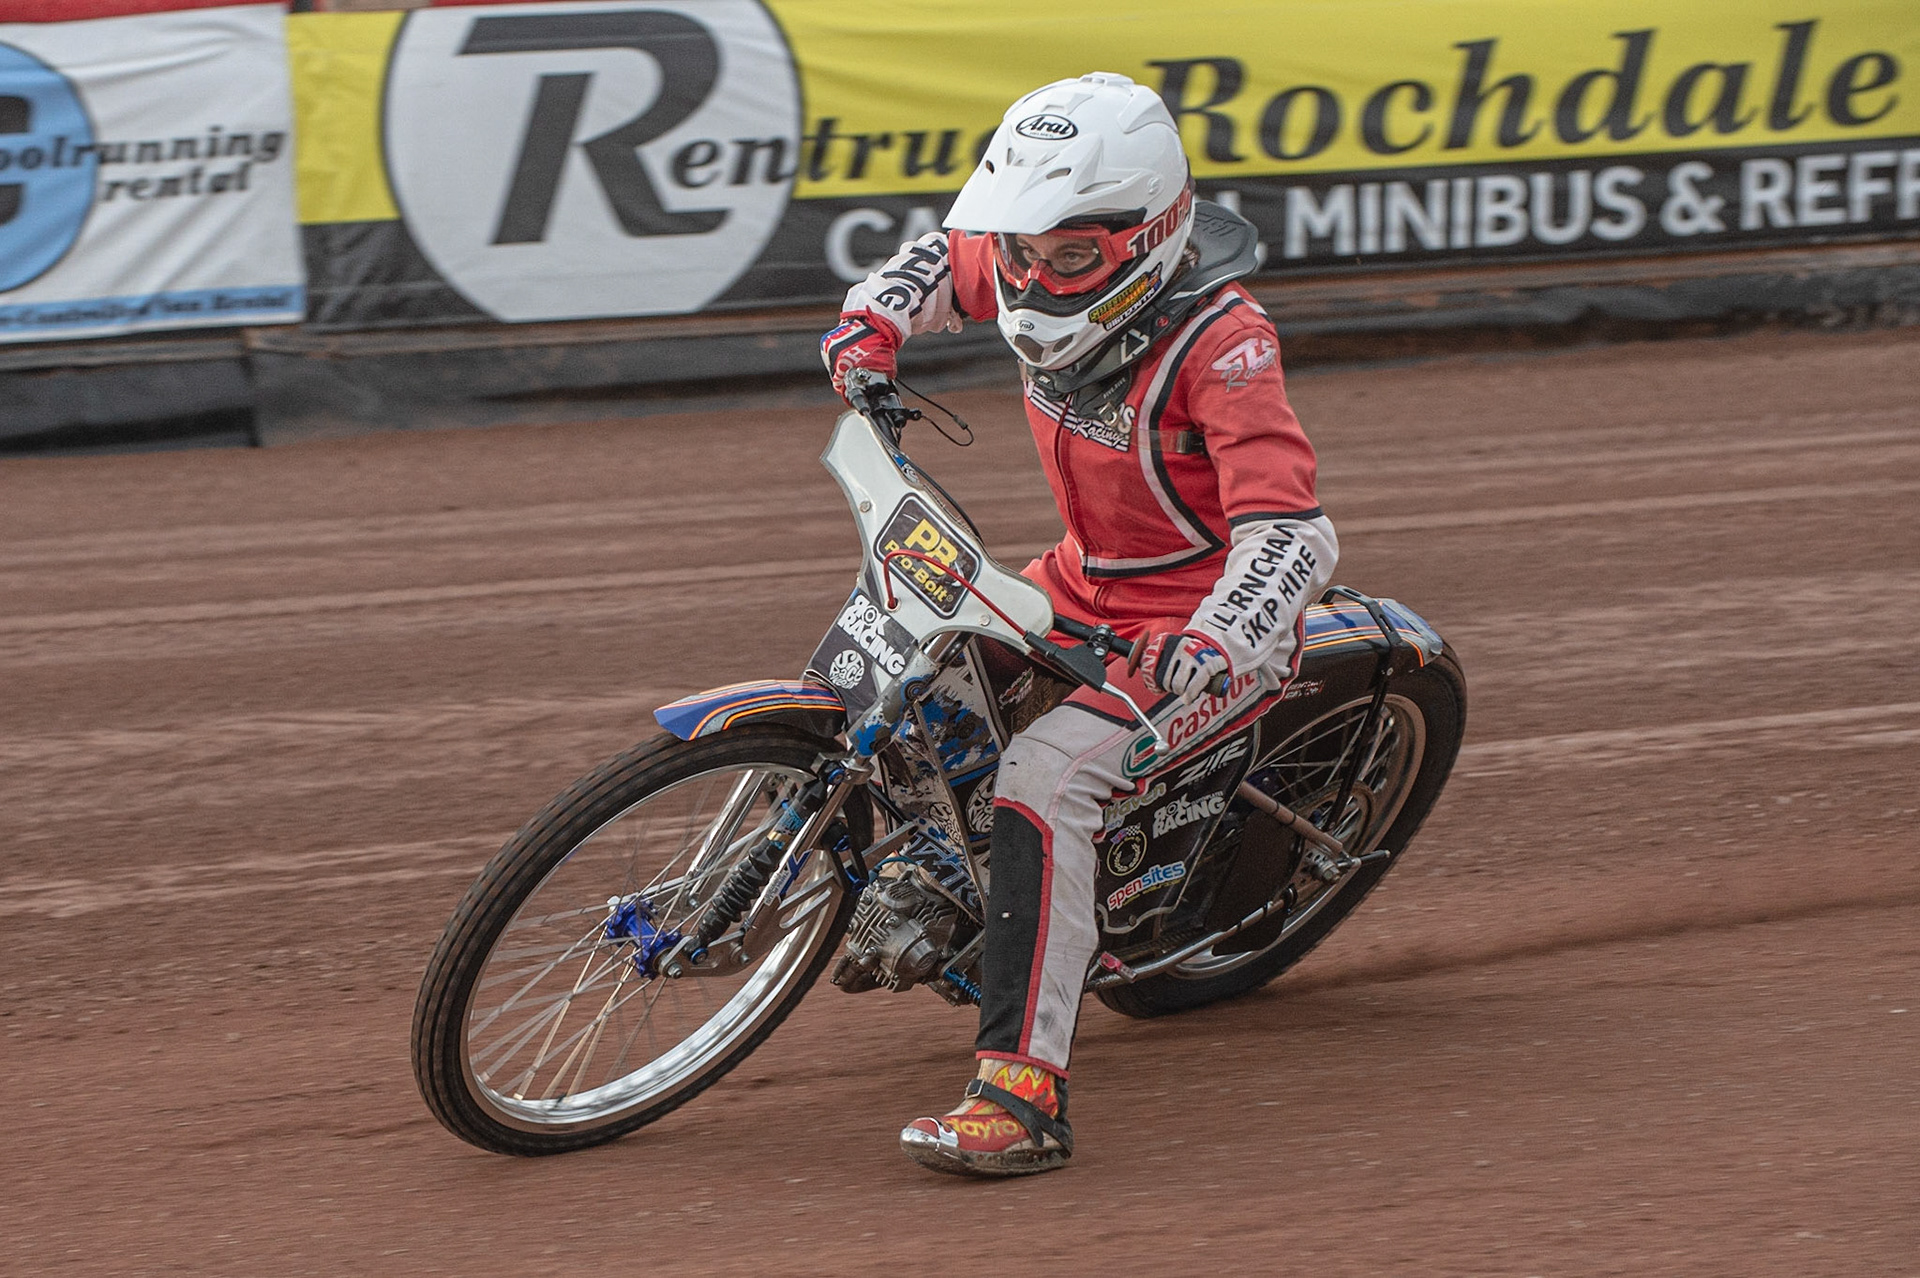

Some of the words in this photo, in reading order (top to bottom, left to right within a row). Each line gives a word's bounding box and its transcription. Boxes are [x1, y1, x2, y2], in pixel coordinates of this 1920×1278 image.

[1145, 18, 1902, 165] Rochdale
[456, 10, 1000, 246] Rentru
[1020, 116, 1071, 135] Arai
[104, 162, 251, 202] rental
[825, 207, 940, 283] CA
[1284, 168, 1646, 258] MINIBUS
[1659, 161, 1727, 237] &
[884, 539, 949, 603] Po-Bolt
[903, 518, 958, 576] PB
[1278, 545, 1317, 605] HIRE
[837, 604, 906, 675] RACING
[1152, 796, 1226, 839] RACING
[1108, 862, 1186, 909] spensites
